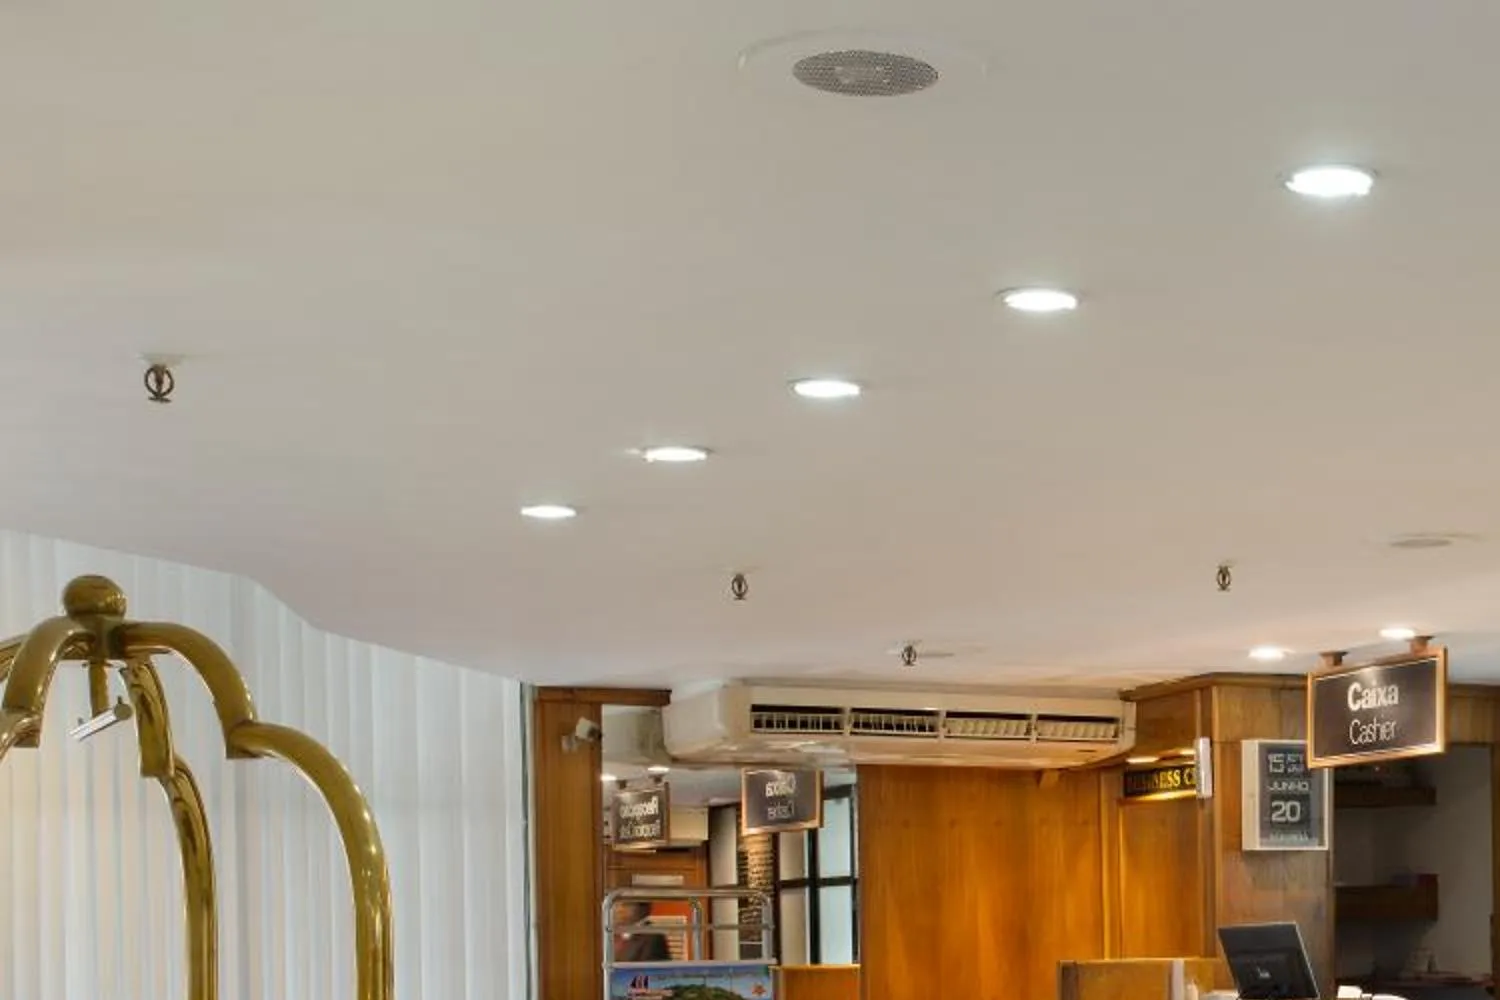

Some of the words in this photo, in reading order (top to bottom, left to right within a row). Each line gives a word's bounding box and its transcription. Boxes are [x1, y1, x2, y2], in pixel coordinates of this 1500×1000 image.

[1346, 679, 1399, 712] Caixa
[1348, 714, 1398, 745] Cashier
[1271, 801, 1301, 823] 20
